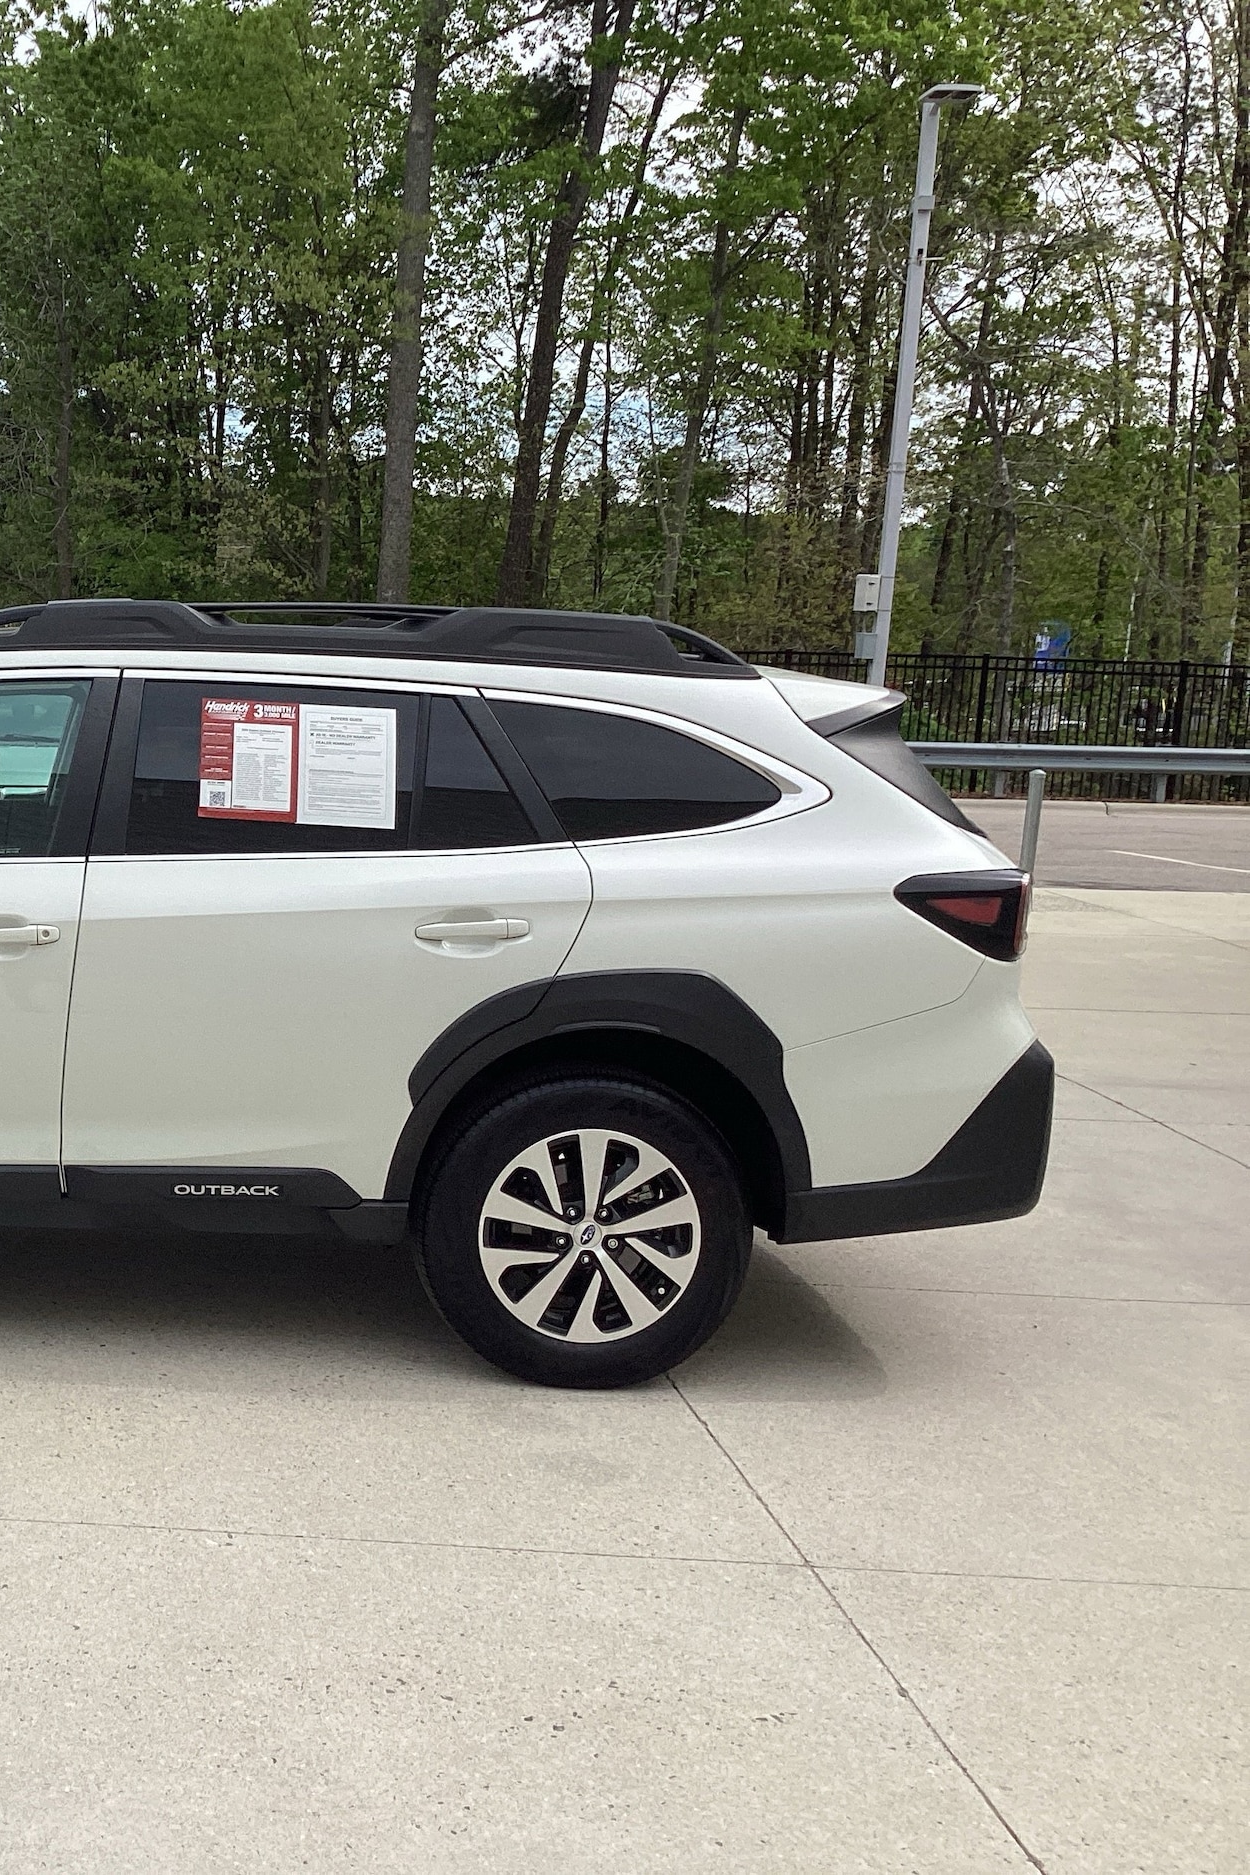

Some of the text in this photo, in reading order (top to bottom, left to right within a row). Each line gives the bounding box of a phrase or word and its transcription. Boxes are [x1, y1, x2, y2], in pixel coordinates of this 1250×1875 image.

[204, 700, 250, 713] Hendrick
[253, 704, 264, 719] 3
[173, 1184, 279, 1196] OUTBACK
